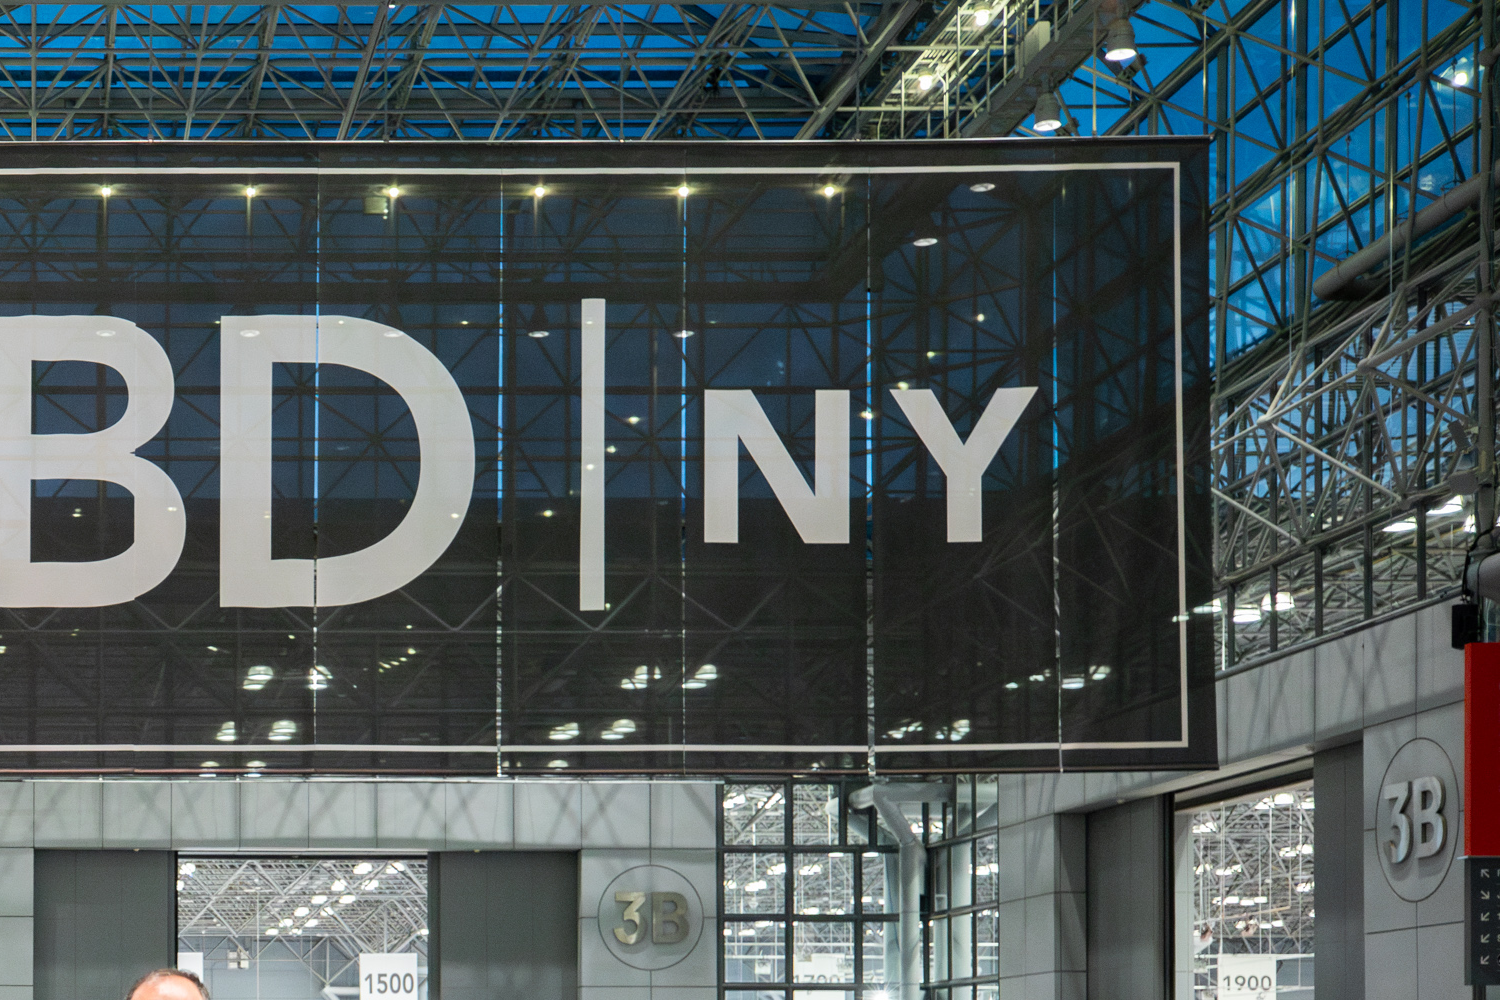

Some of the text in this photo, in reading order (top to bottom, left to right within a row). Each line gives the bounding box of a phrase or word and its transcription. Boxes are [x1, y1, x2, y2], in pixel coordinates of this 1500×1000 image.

[703, 386, 1038, 544] NY
[1383, 775, 1446, 863] 3B
[613, 891, 689, 945] 3B
[364, 973, 415, 994] 1500
[1223, 975, 1272, 991] 1900
